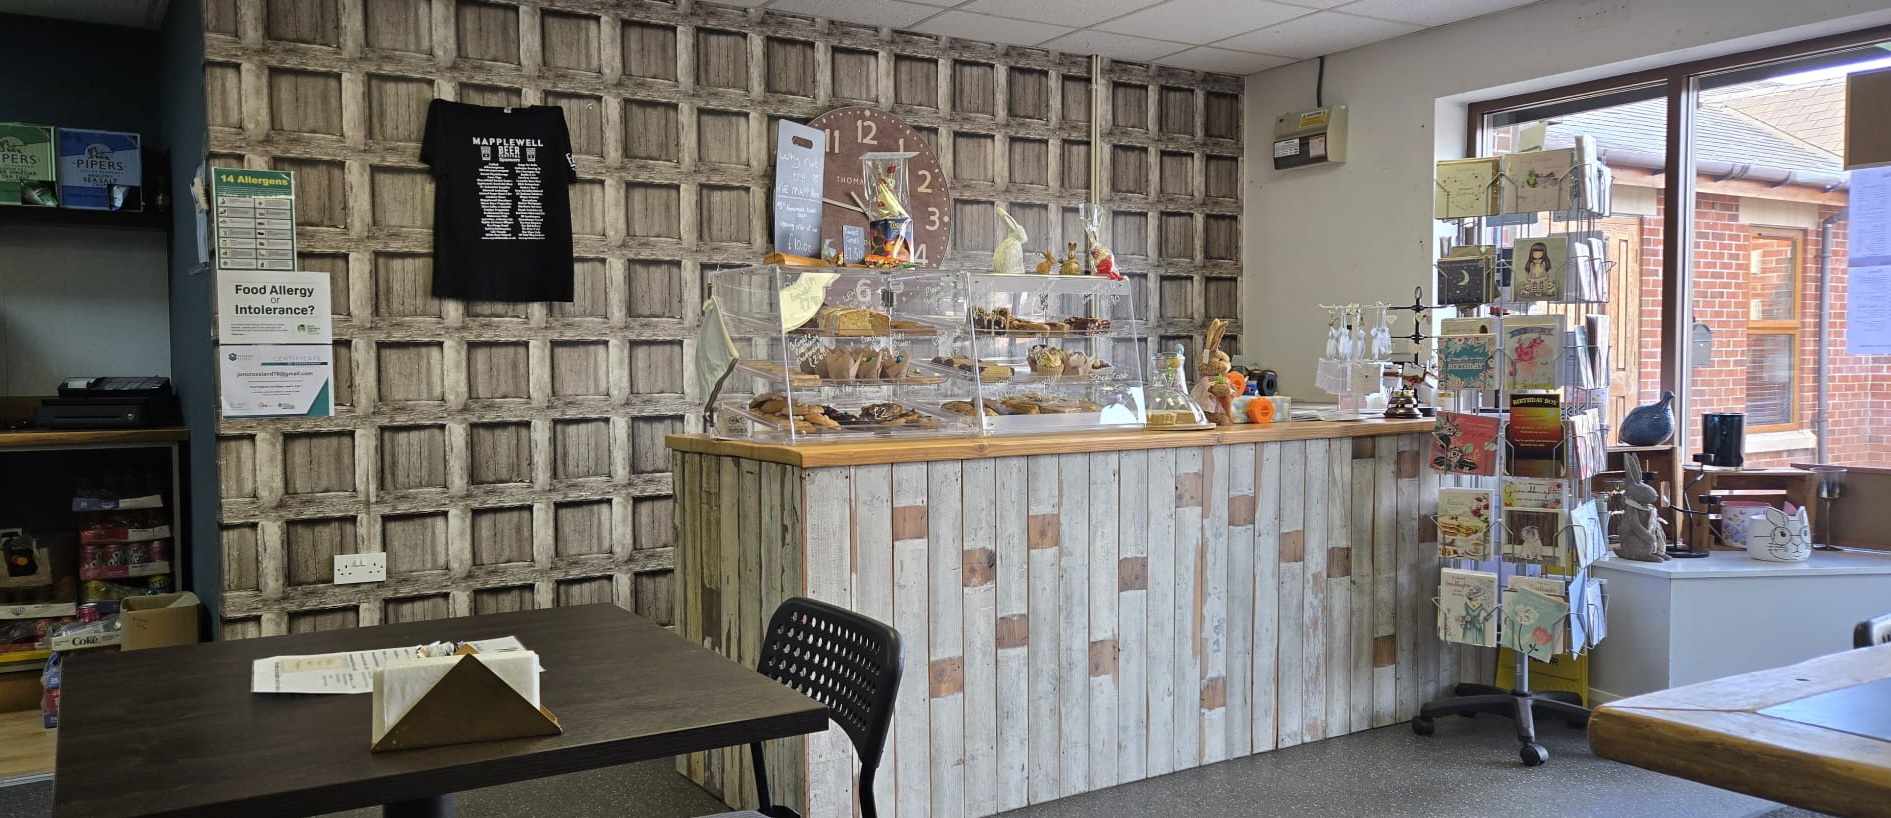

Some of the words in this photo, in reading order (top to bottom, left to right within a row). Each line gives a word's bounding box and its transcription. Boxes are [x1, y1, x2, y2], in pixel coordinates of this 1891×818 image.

[857, 119, 878, 145] 12
[472, 137, 544, 147] MAPPLEWELL
[825, 128, 840, 154] 11
[498, 146, 520, 155] BEER
[2, 153, 37, 165] PERS
[77, 159, 124, 171] PIPERS
[221, 174, 234, 183] 14
[237, 175, 289, 187] Allergens
[836, 176, 865, 185] THOMA
[917, 169, 933, 193] 2
[925, 207, 940, 231] 3
[914, 243, 929, 267] 4
[235, 284, 267, 295] Food
[269, 285, 315, 298] Allergy
[856, 279, 872, 304] 6
[235, 304, 315, 315] Intolerance?
[1512, 397, 1543, 405] BIRTHDAY
[1544, 398, 1558, 406] BOY
[72, 636, 98, 646] Coke
